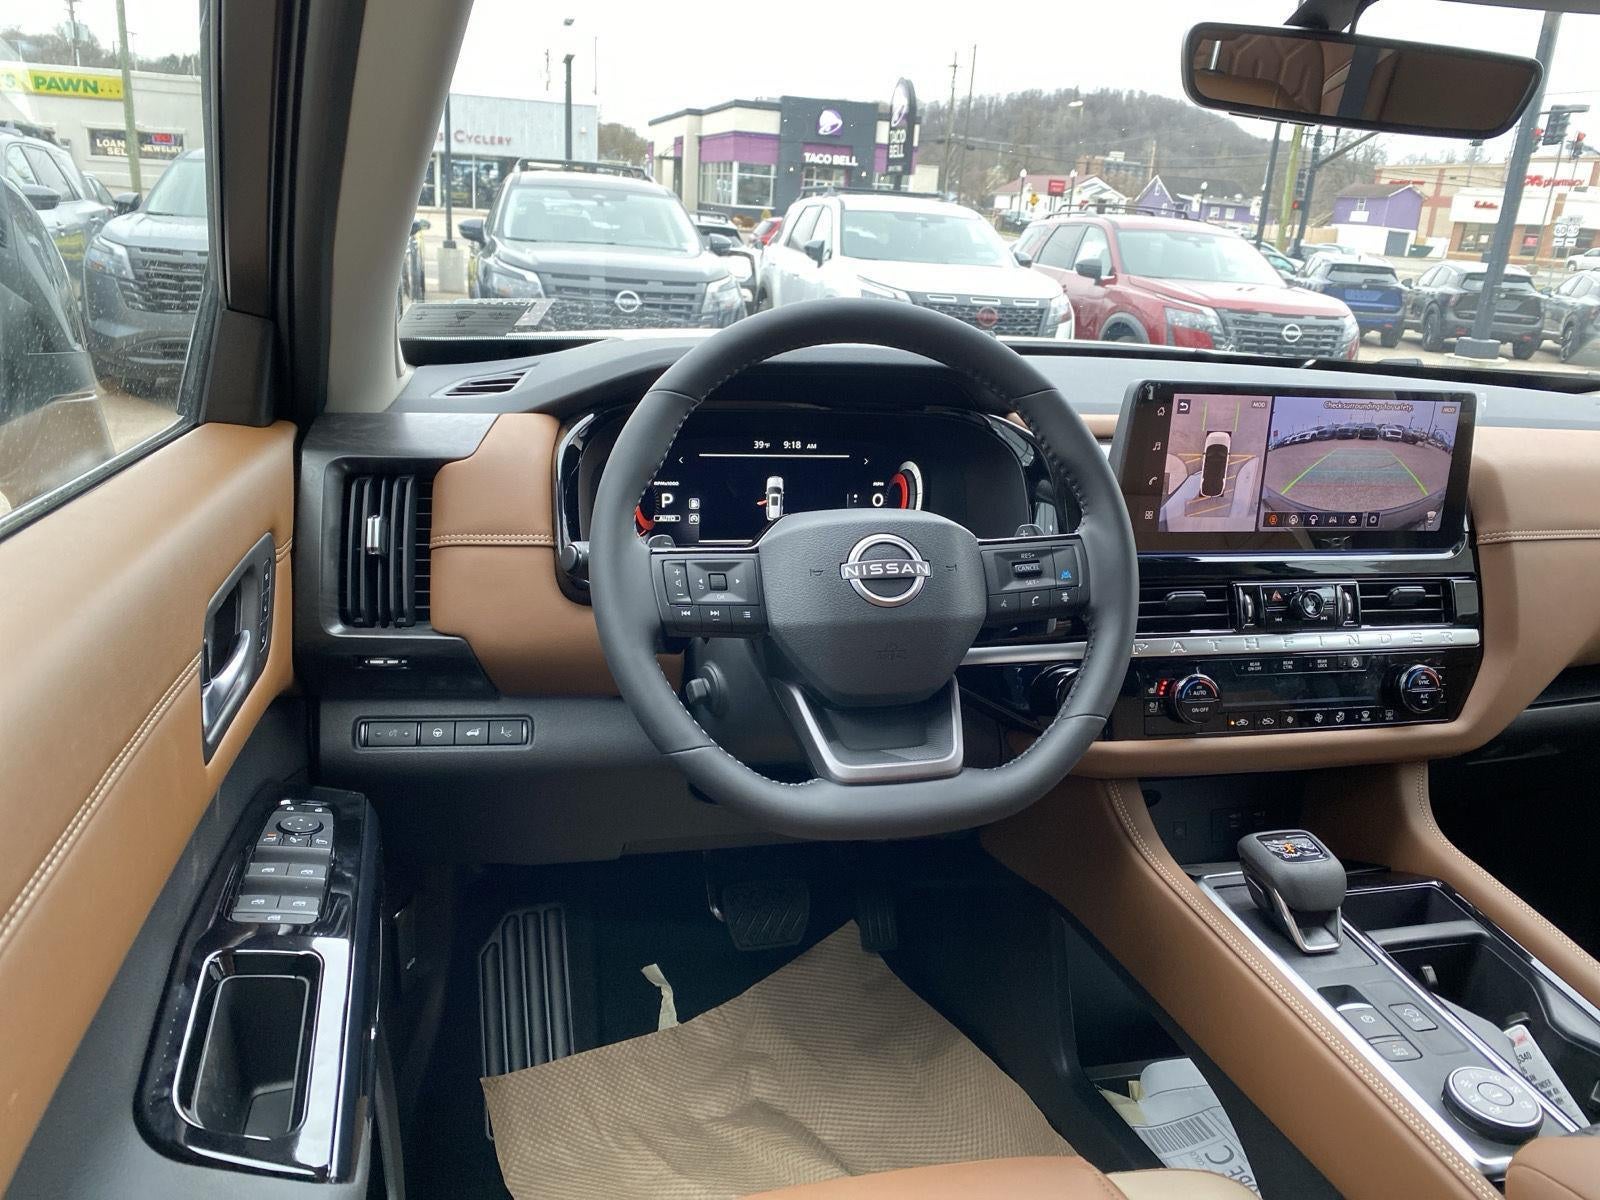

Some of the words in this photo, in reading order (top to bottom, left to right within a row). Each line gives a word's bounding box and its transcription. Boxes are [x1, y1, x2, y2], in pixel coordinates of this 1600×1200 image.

[96, 138, 126, 148] LOAN
[107, 147, 128, 156] SEL
[804, 152, 832, 165] TACO
[832, 155, 859, 167] BELL
[1323, 401, 1341, 410] Check
[1343, 402, 1382, 412] surroundings
[1393, 403, 1414, 412] safety
[783, 440, 801, 449] 9:18
[661, 493, 674, 508] P
[844, 563, 929, 577] NISSAN
[1017, 564, 1040, 572] CANCEL
[1131, 630, 1456, 655] PATHFINDER
